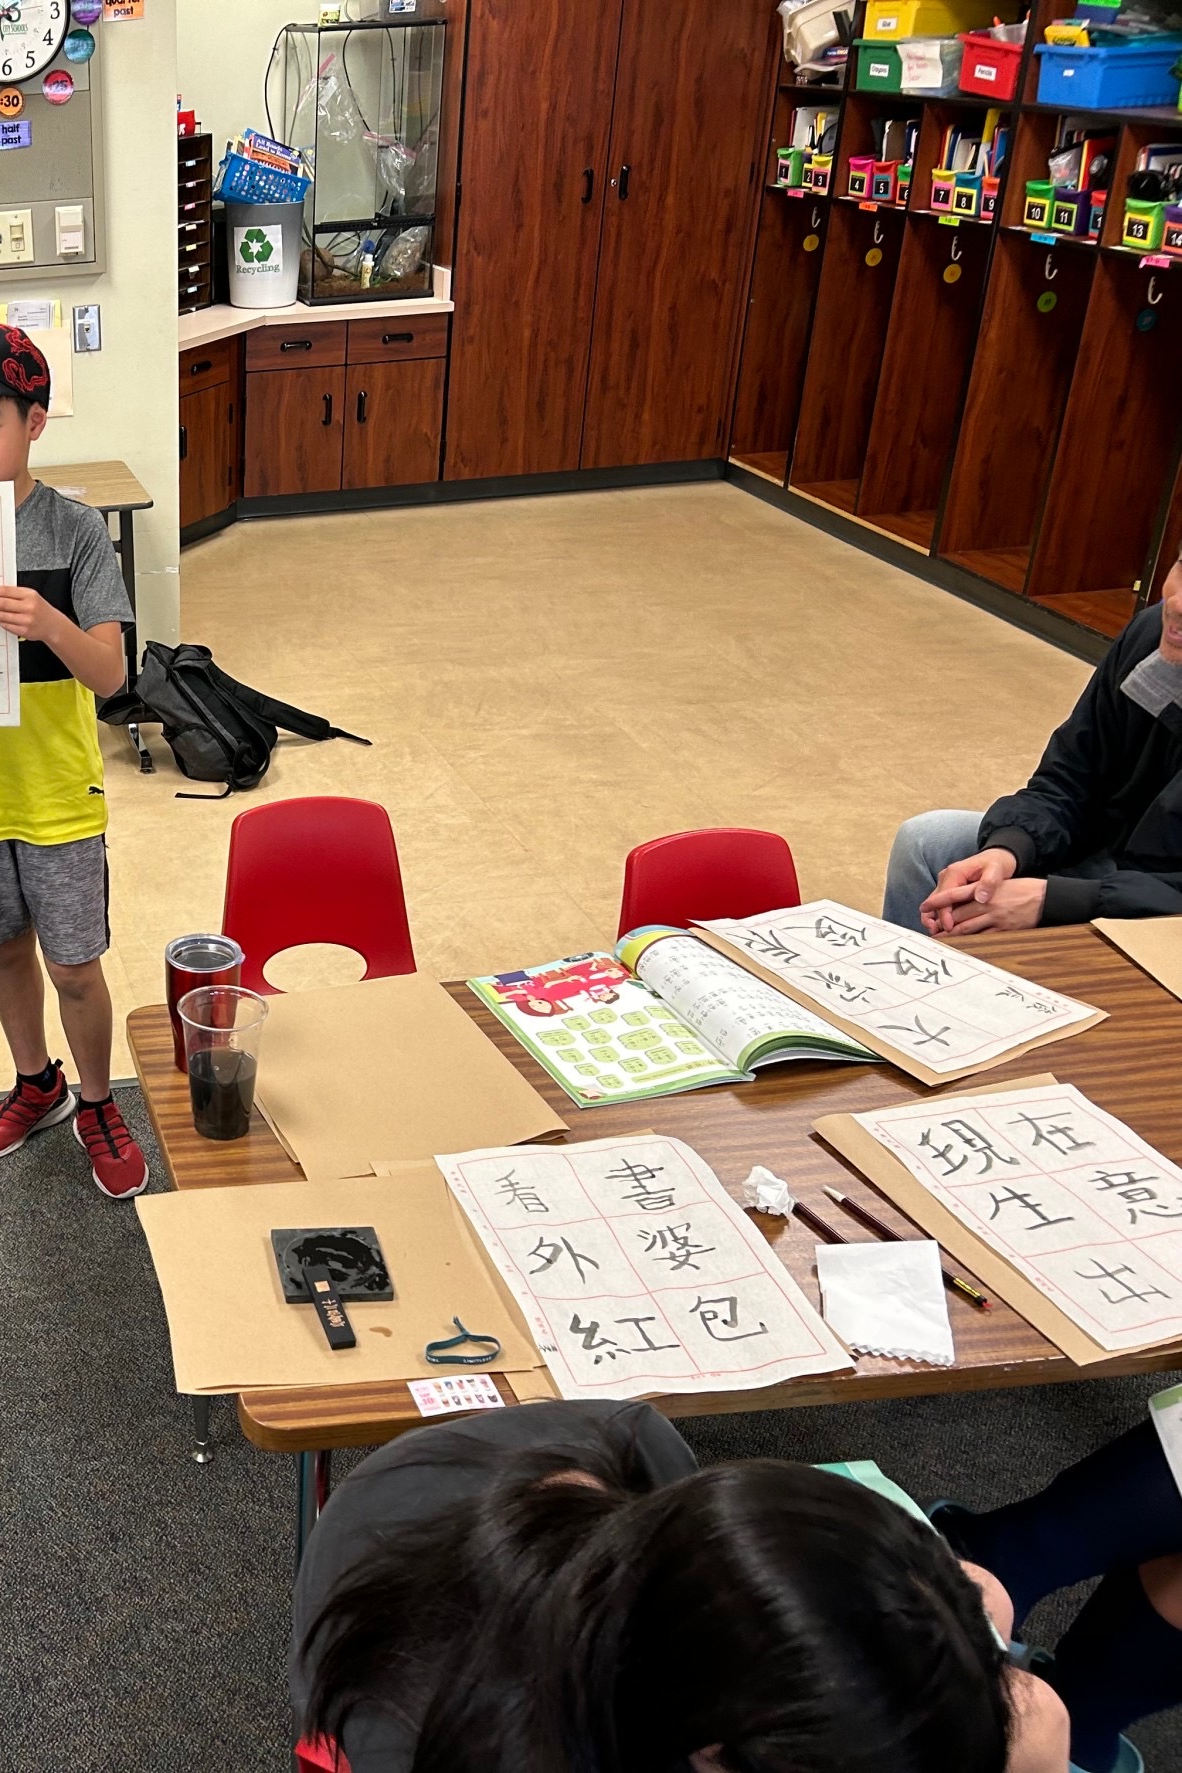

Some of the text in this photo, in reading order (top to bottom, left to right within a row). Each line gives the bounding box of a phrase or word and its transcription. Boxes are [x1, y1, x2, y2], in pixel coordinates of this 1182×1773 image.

[50, 2, 60, 19] 3
[114, 6, 134, 17] past
[42, 28, 54, 46] 4
[25, 50, 36, 68] 5
[1, 58, 13, 76] 6
[0, 94, 20, 107] :30
[1, 123, 21, 134] half
[1, 135, 22, 147] past
[818, 176, 824, 186] 3
[854, 180, 860, 191] 4
[879, 183, 885, 193] 5
[939, 191, 945, 202] 7
[960, 197, 967, 208] 8
[988, 199, 995, 210] 9
[1031, 207, 1041, 220] 10
[1060, 211, 1068, 224] 11
[1132, 223, 1144, 237] 13
[235, 263, 281, 275] Recycling
